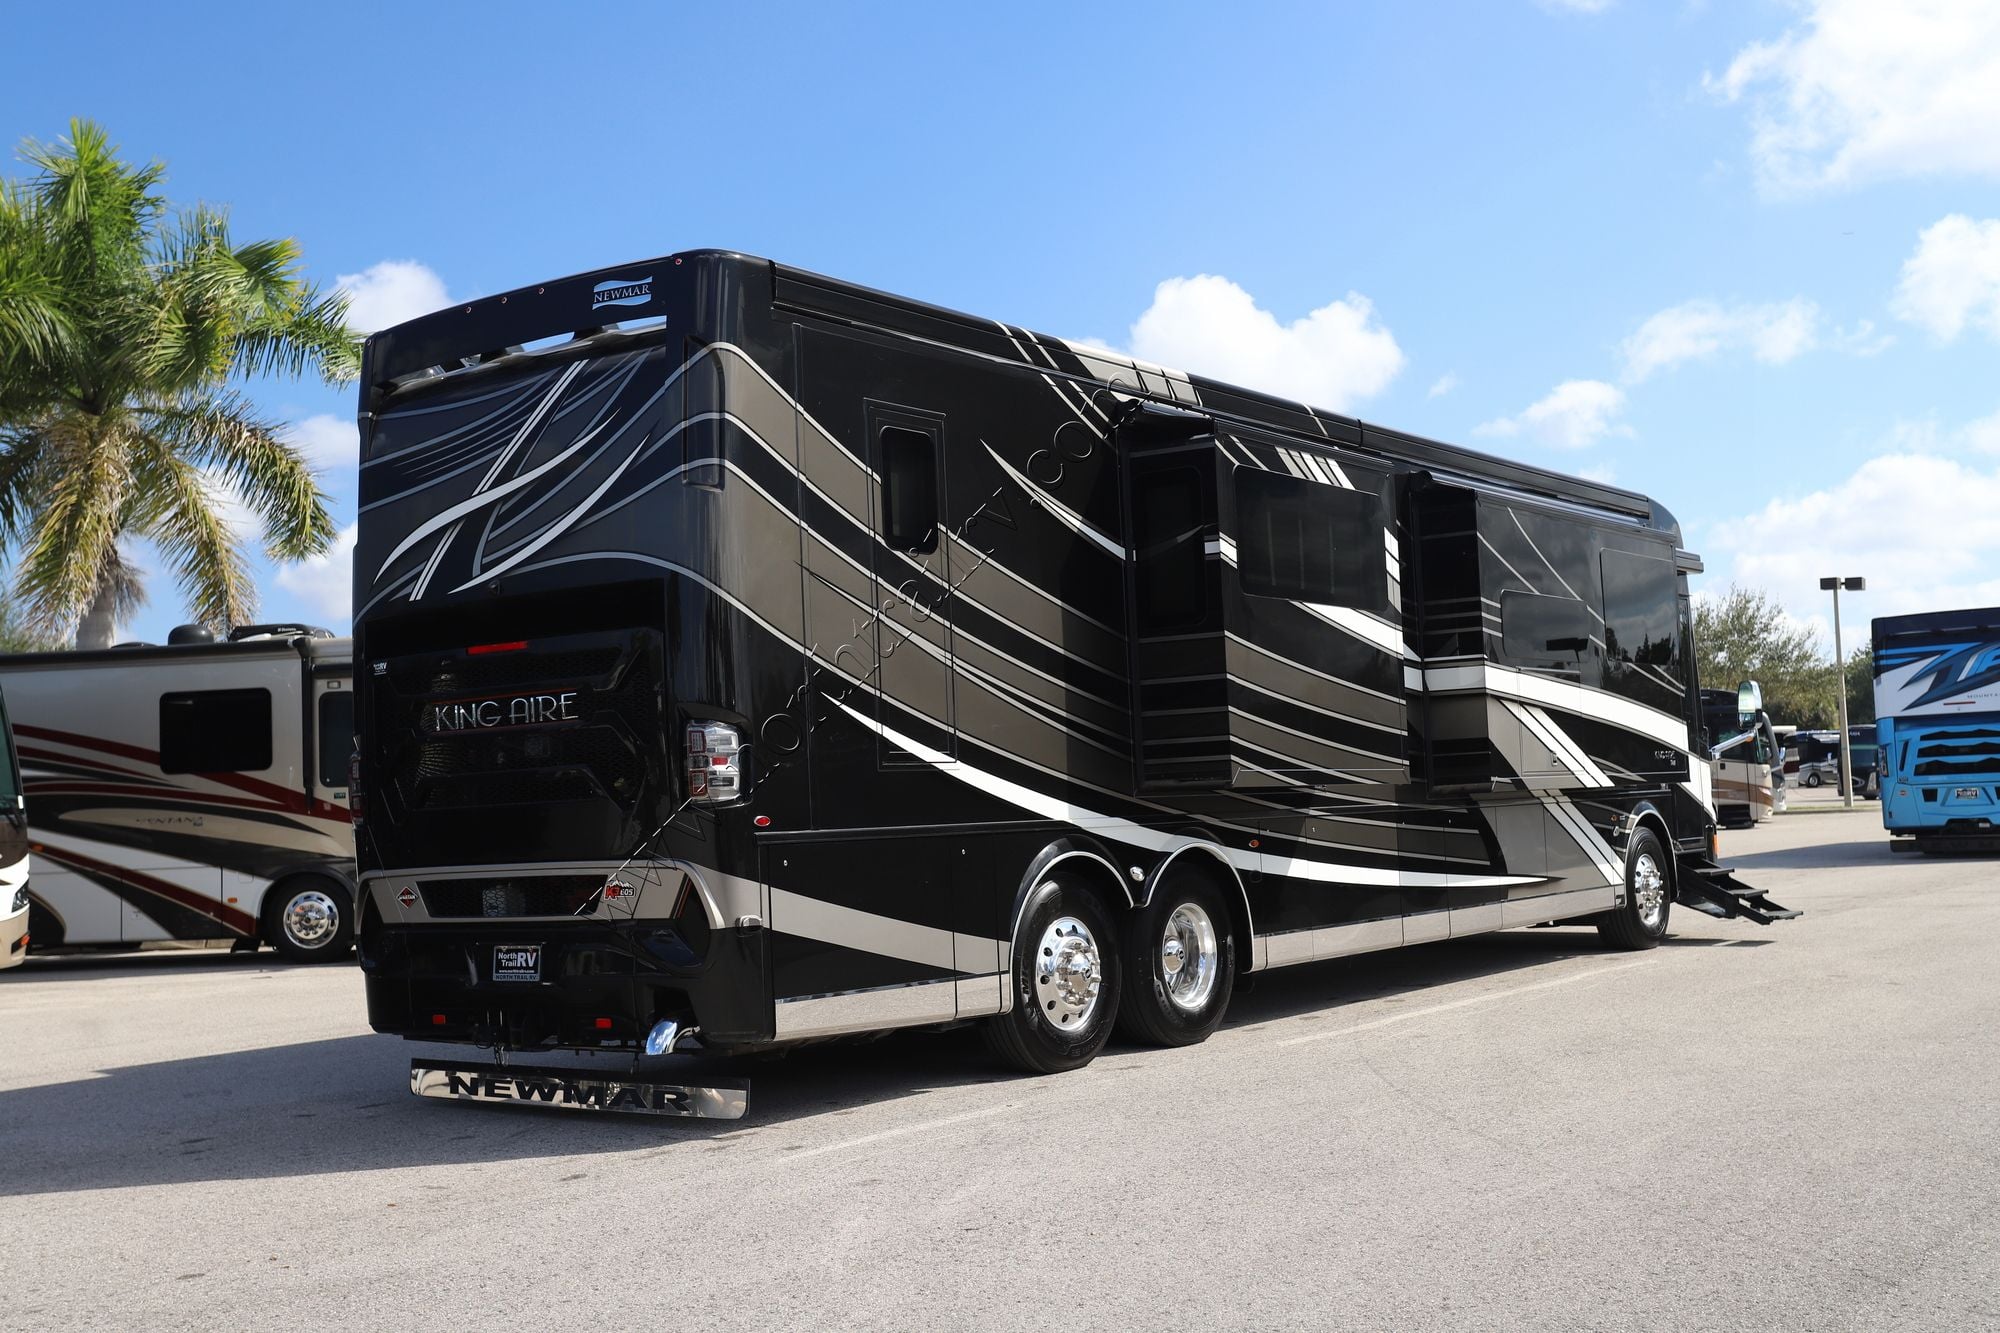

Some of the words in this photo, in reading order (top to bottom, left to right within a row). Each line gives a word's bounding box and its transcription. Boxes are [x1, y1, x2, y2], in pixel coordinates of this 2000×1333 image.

[594, 284, 651, 303] NEWMAR
[435, 701, 502, 732] KING
[509, 693, 579, 725] AIRE
[498, 952, 517, 960] North
[501, 959, 517, 967] Trail
[516, 952, 537, 967] RV
[449, 1075, 691, 1113] NEWMAR
